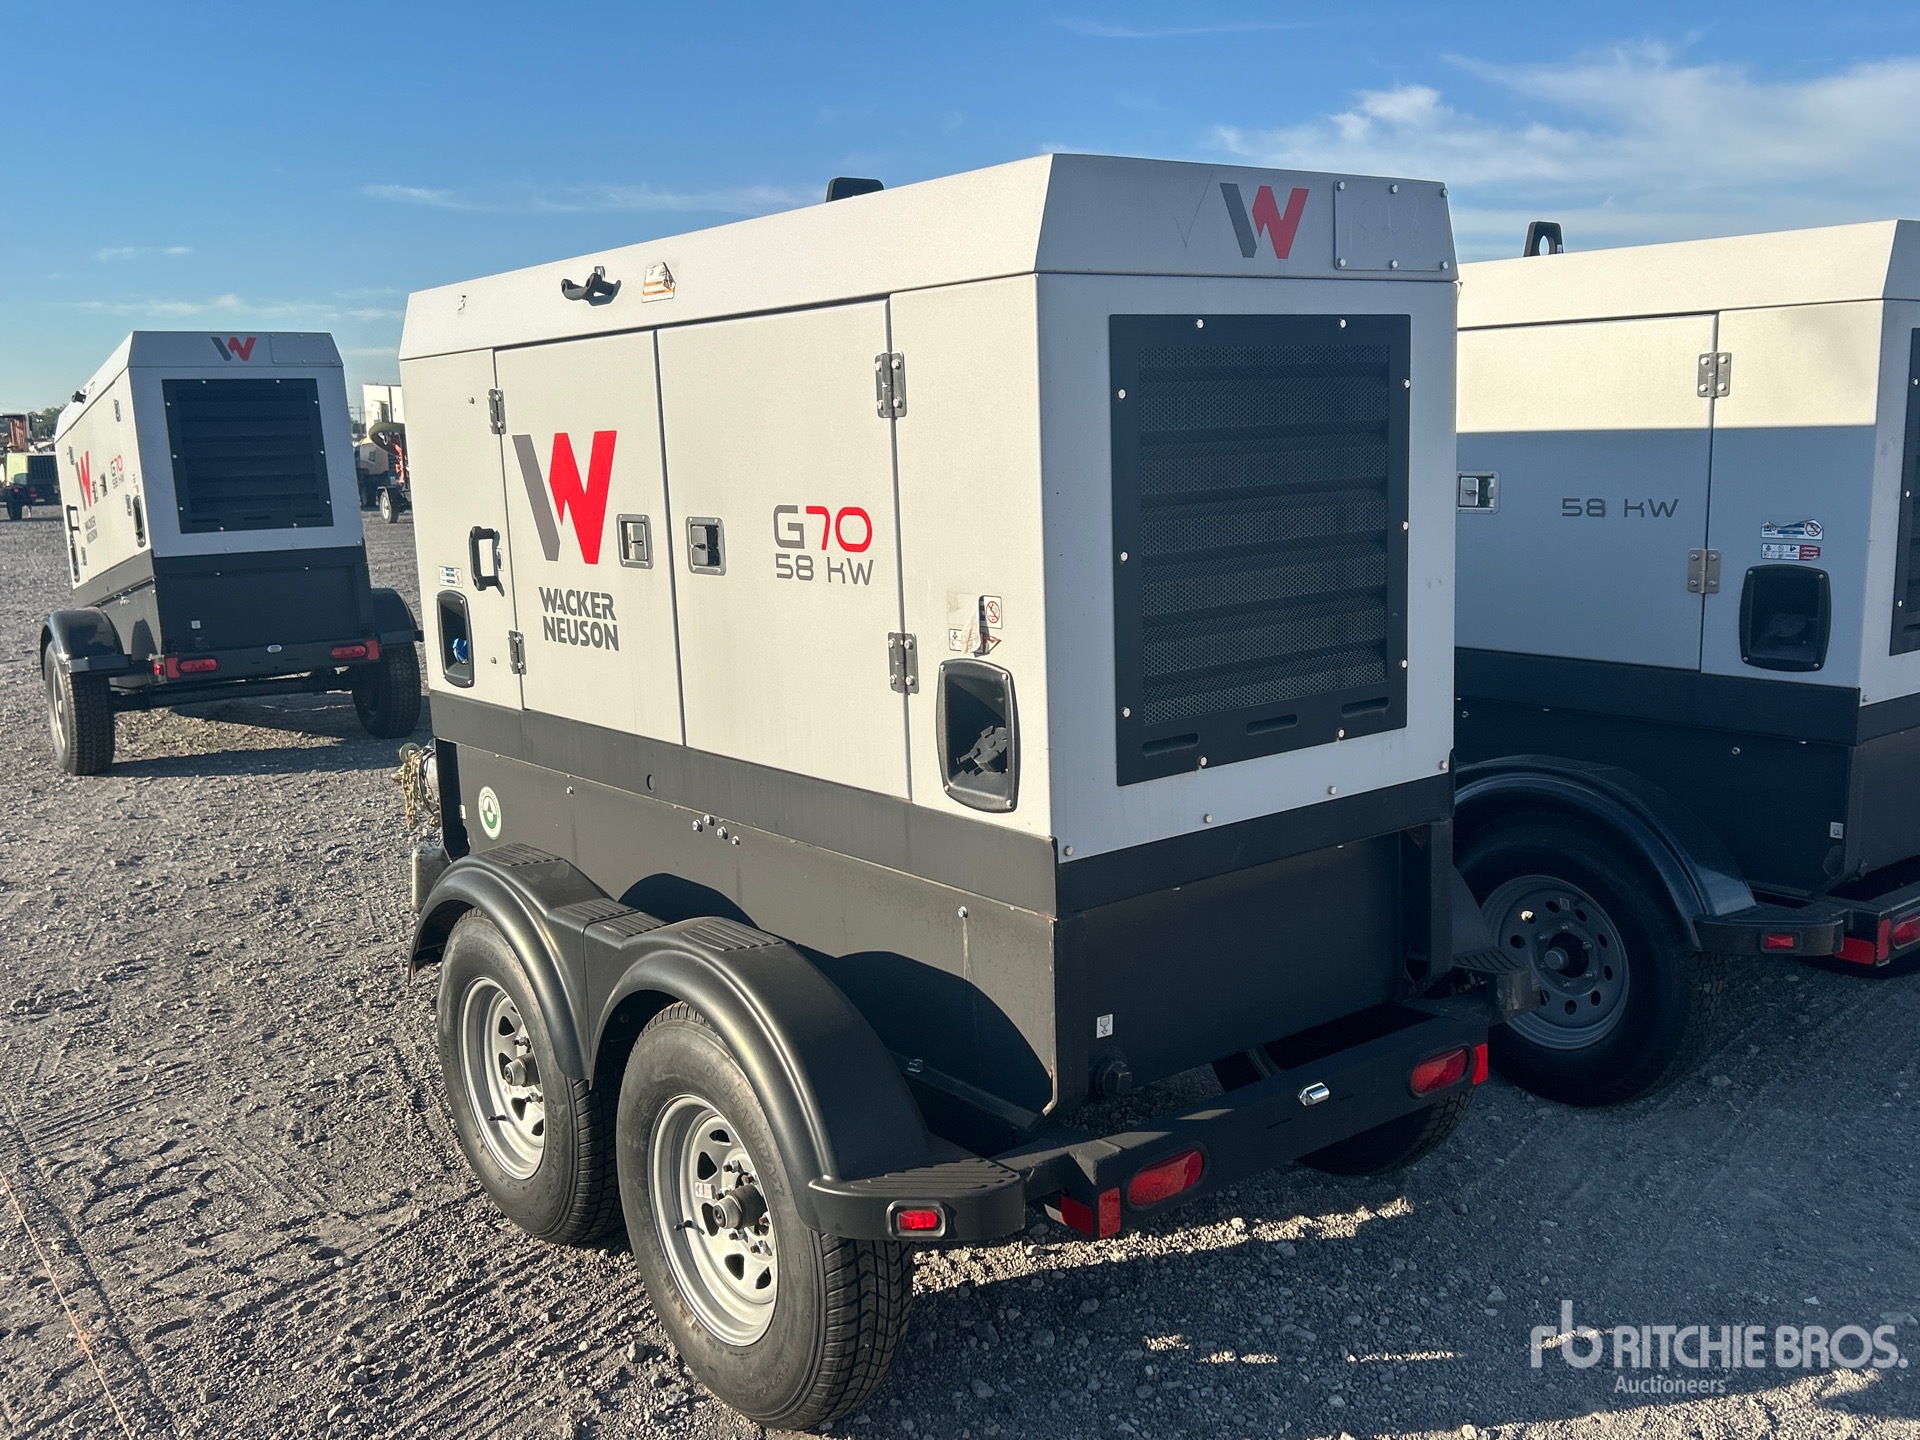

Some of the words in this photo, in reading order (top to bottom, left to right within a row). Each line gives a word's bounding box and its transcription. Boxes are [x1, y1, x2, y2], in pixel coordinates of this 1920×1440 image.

[1562, 498, 1606, 517] 58
[1624, 498, 1680, 518] kW
[773, 505, 873, 553] G70
[775, 553, 814, 582] 58
[827, 556, 874, 586] kW
[538, 586, 617, 621] WACKER
[542, 615, 619, 652] NEUSON
